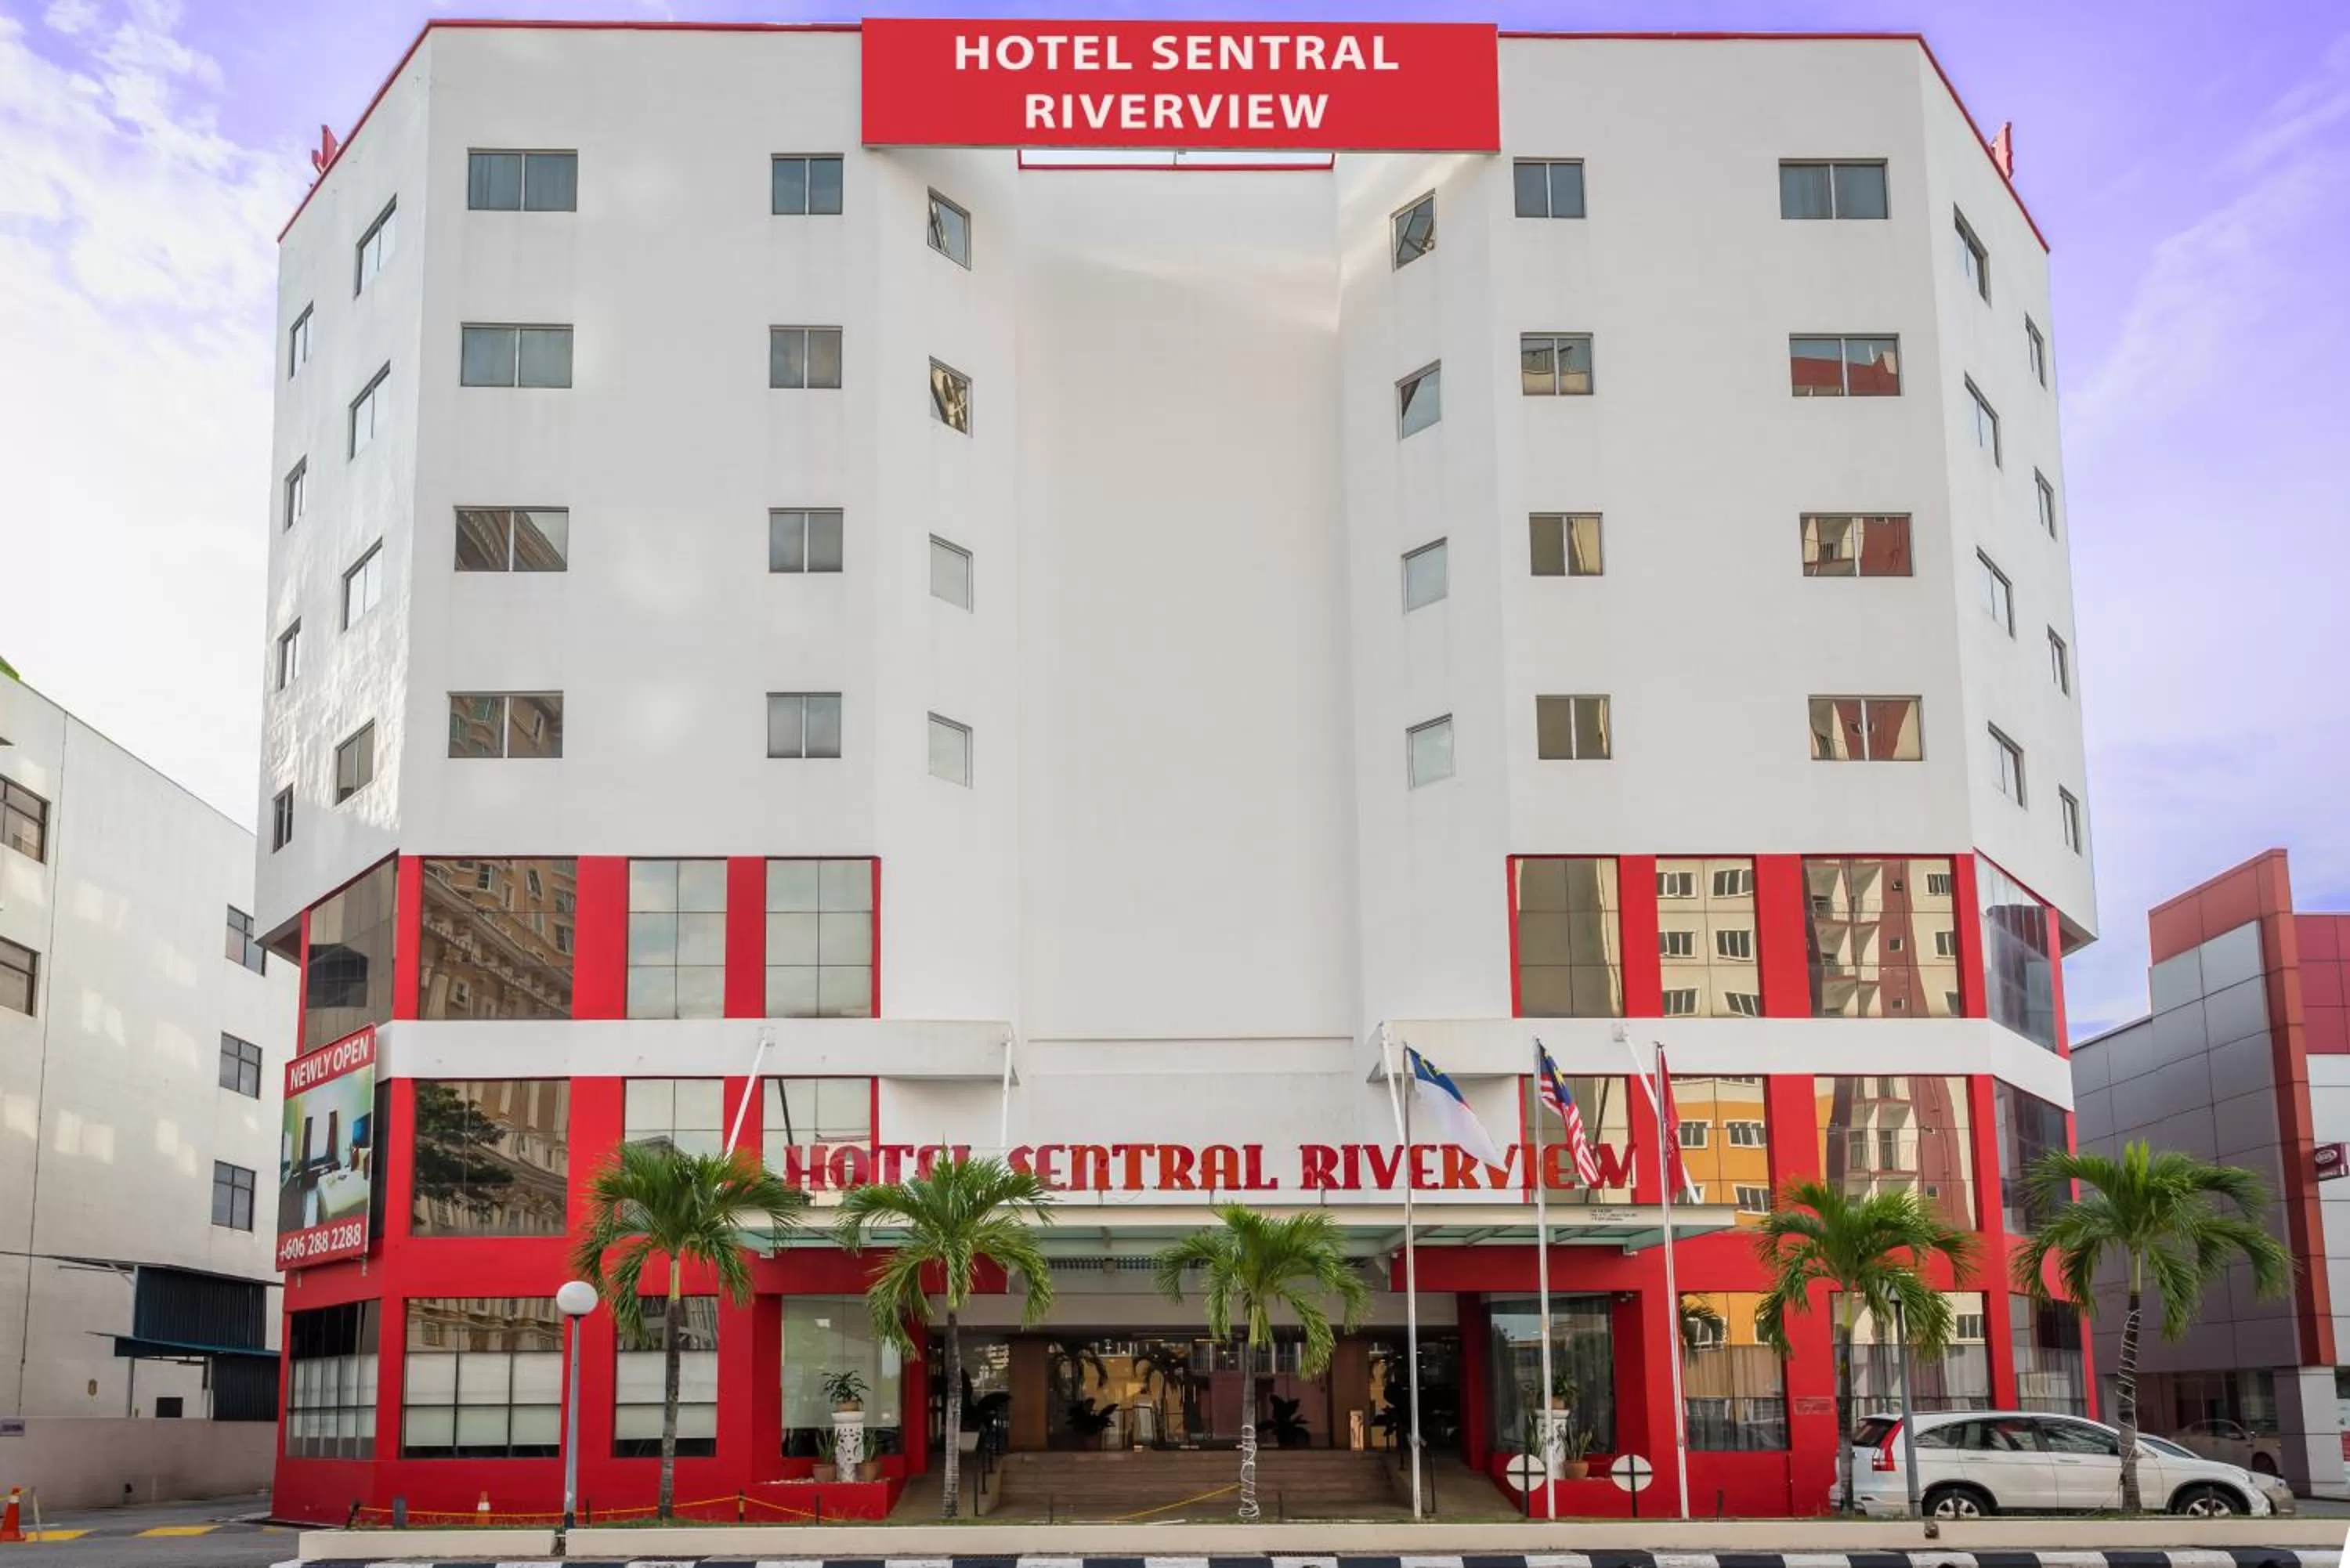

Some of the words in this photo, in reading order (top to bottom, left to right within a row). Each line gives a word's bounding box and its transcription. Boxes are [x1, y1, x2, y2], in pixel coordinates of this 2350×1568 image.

[954, 34, 1133, 70] HOTEL
[1152, 34, 1400, 71] SENTRAL
[1025, 92, 1330, 129] RIVERVIEW
[289, 1050, 332, 1091] NEWLY
[333, 1034, 370, 1072] OPEN
[1007, 1143, 1279, 1191] SENTRAL
[1299, 1143, 1637, 1190] RIVERVIEW
[279, 1235, 306, 1262] +606
[307, 1230, 329, 1255] 288
[331, 1223, 362, 1251] 2288
